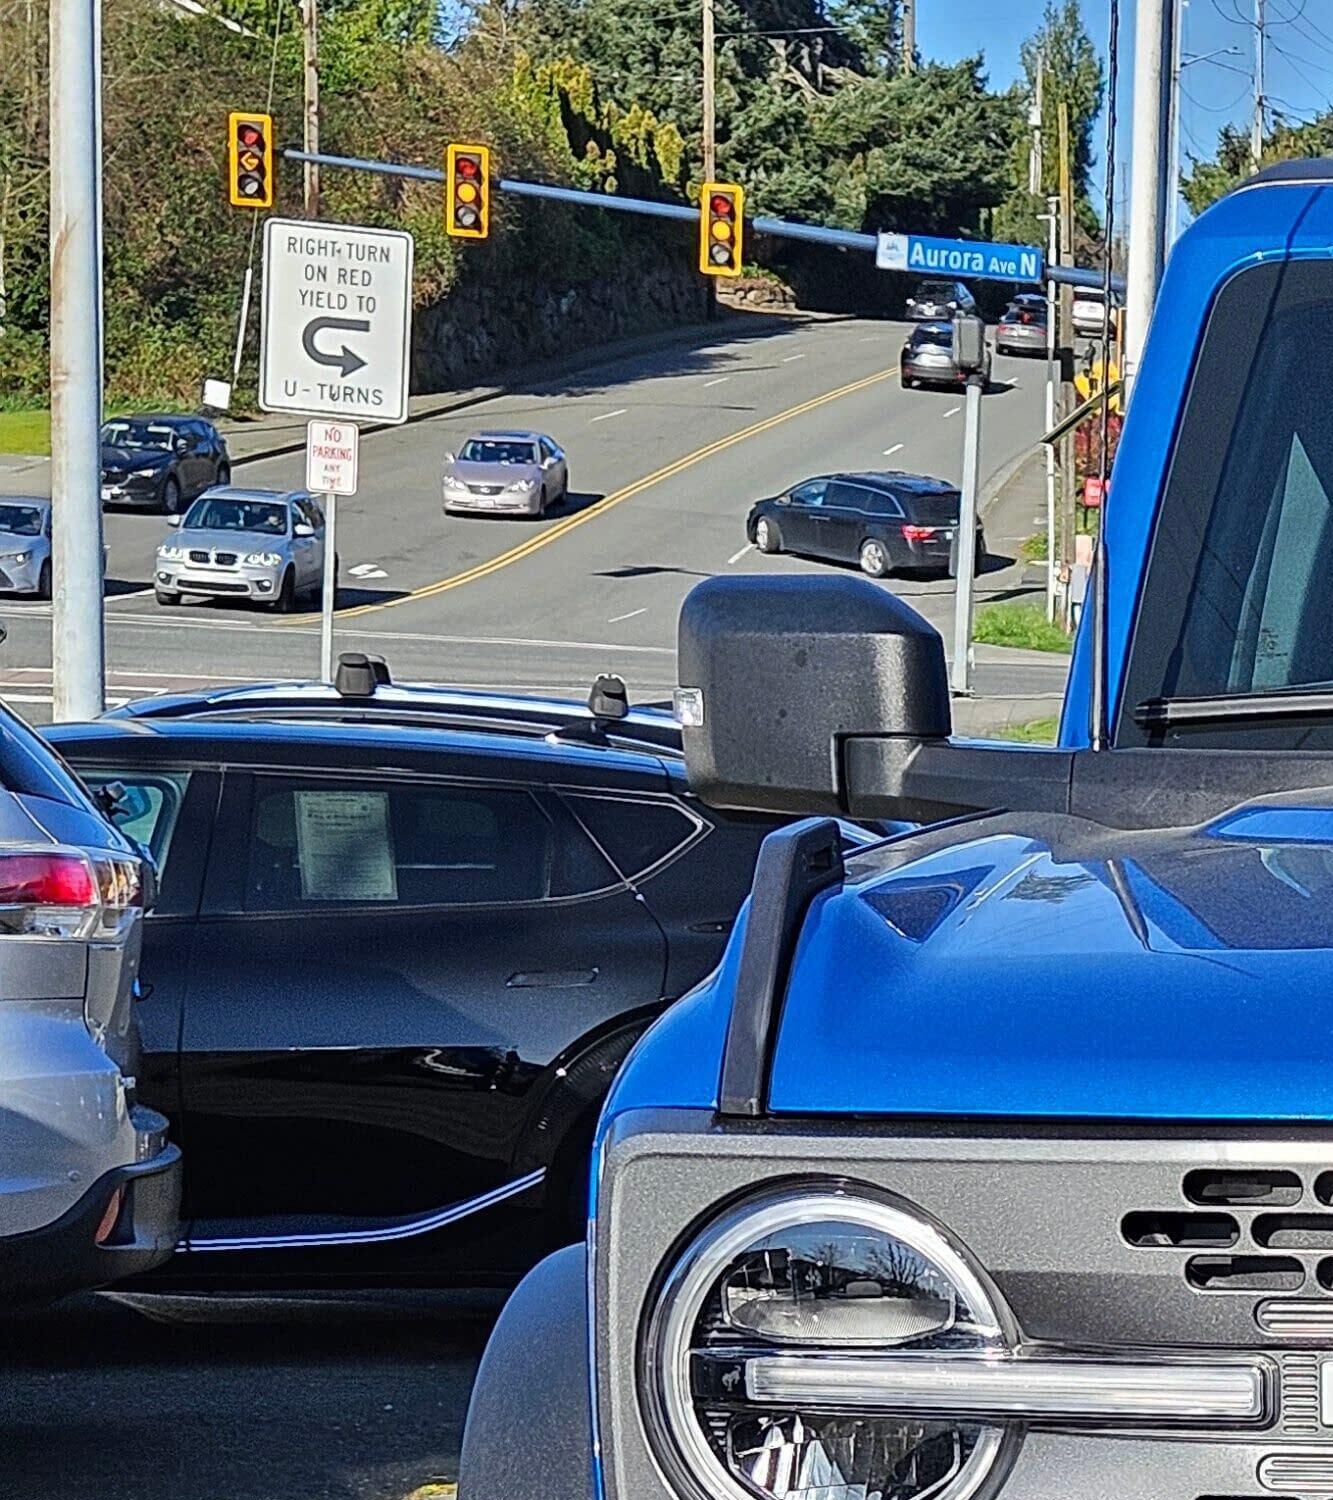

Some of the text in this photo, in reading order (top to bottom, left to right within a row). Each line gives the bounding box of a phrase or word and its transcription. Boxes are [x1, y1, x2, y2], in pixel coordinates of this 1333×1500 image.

[287, 236, 390, 263] RIGHT TURN
[910, 242, 1036, 277] Aurora Ave N
[304, 264, 372, 287] ON RED
[299, 289, 376, 313] YIELD TO
[324, 426, 342, 443] NO
[312, 445, 352, 462] PARKING
